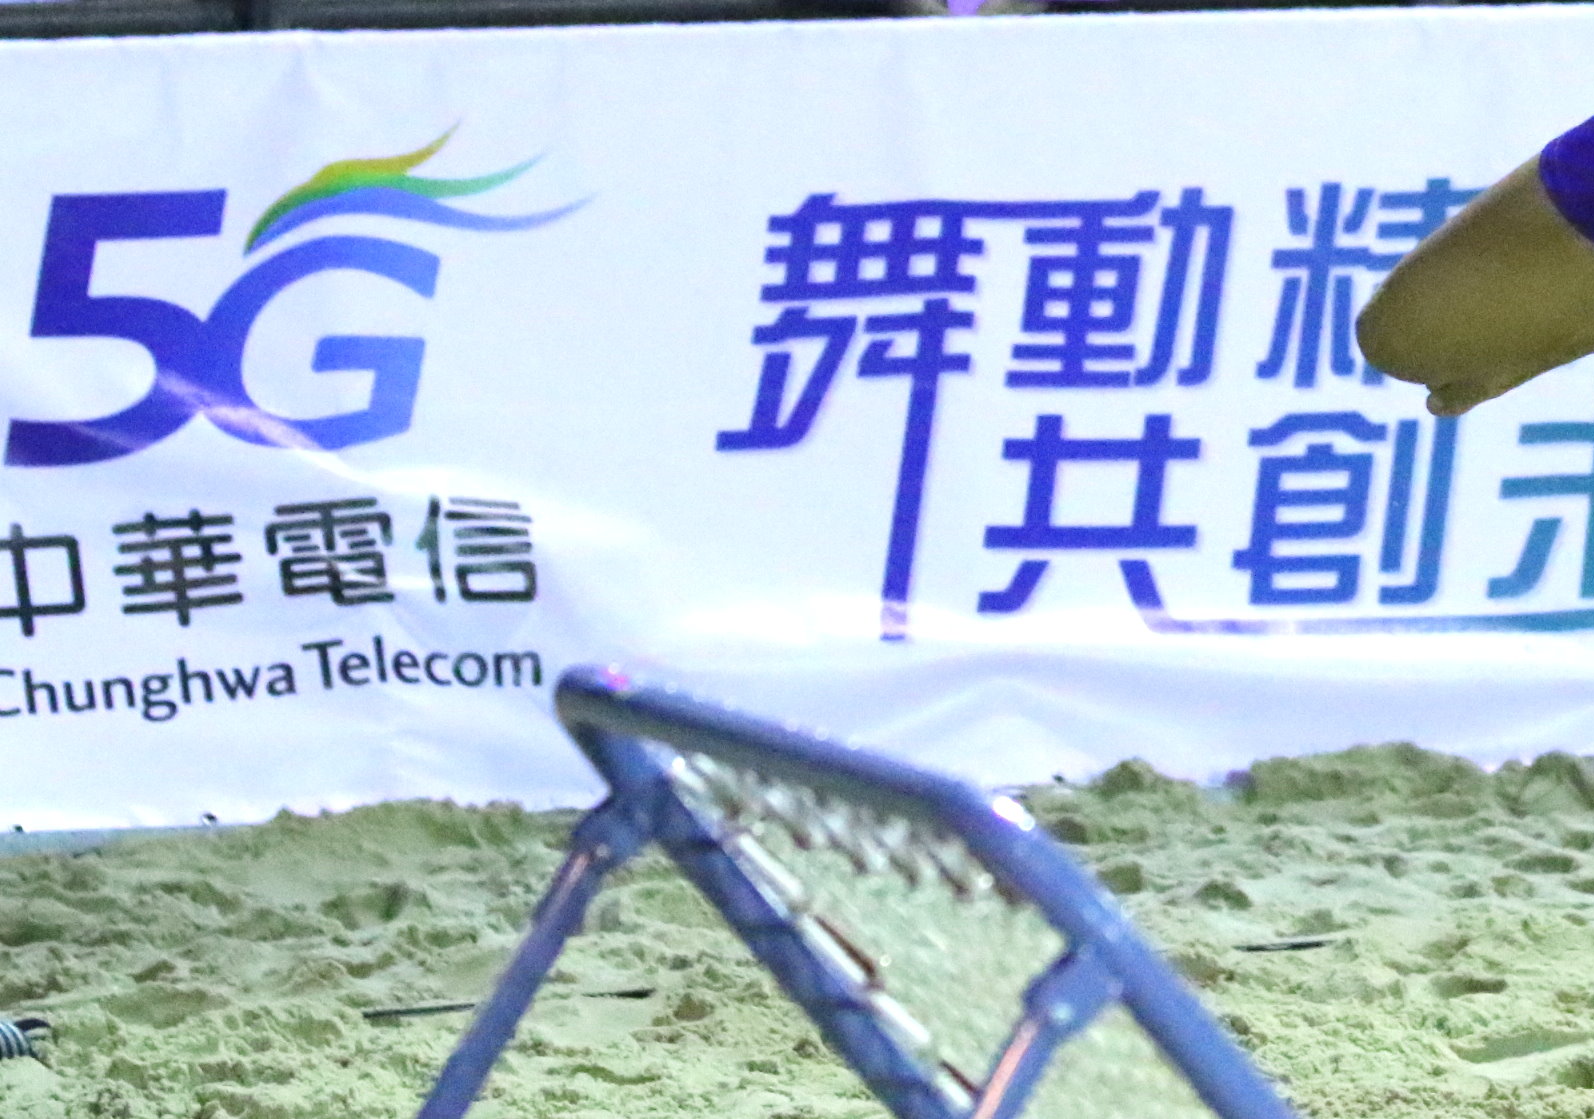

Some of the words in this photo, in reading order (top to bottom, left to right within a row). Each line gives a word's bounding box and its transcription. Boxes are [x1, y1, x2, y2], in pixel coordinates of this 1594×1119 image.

[4, 189, 441, 467] 5G
[0, 497, 537, 637] 中華電信
[302, 635, 542, 690] Telecom
